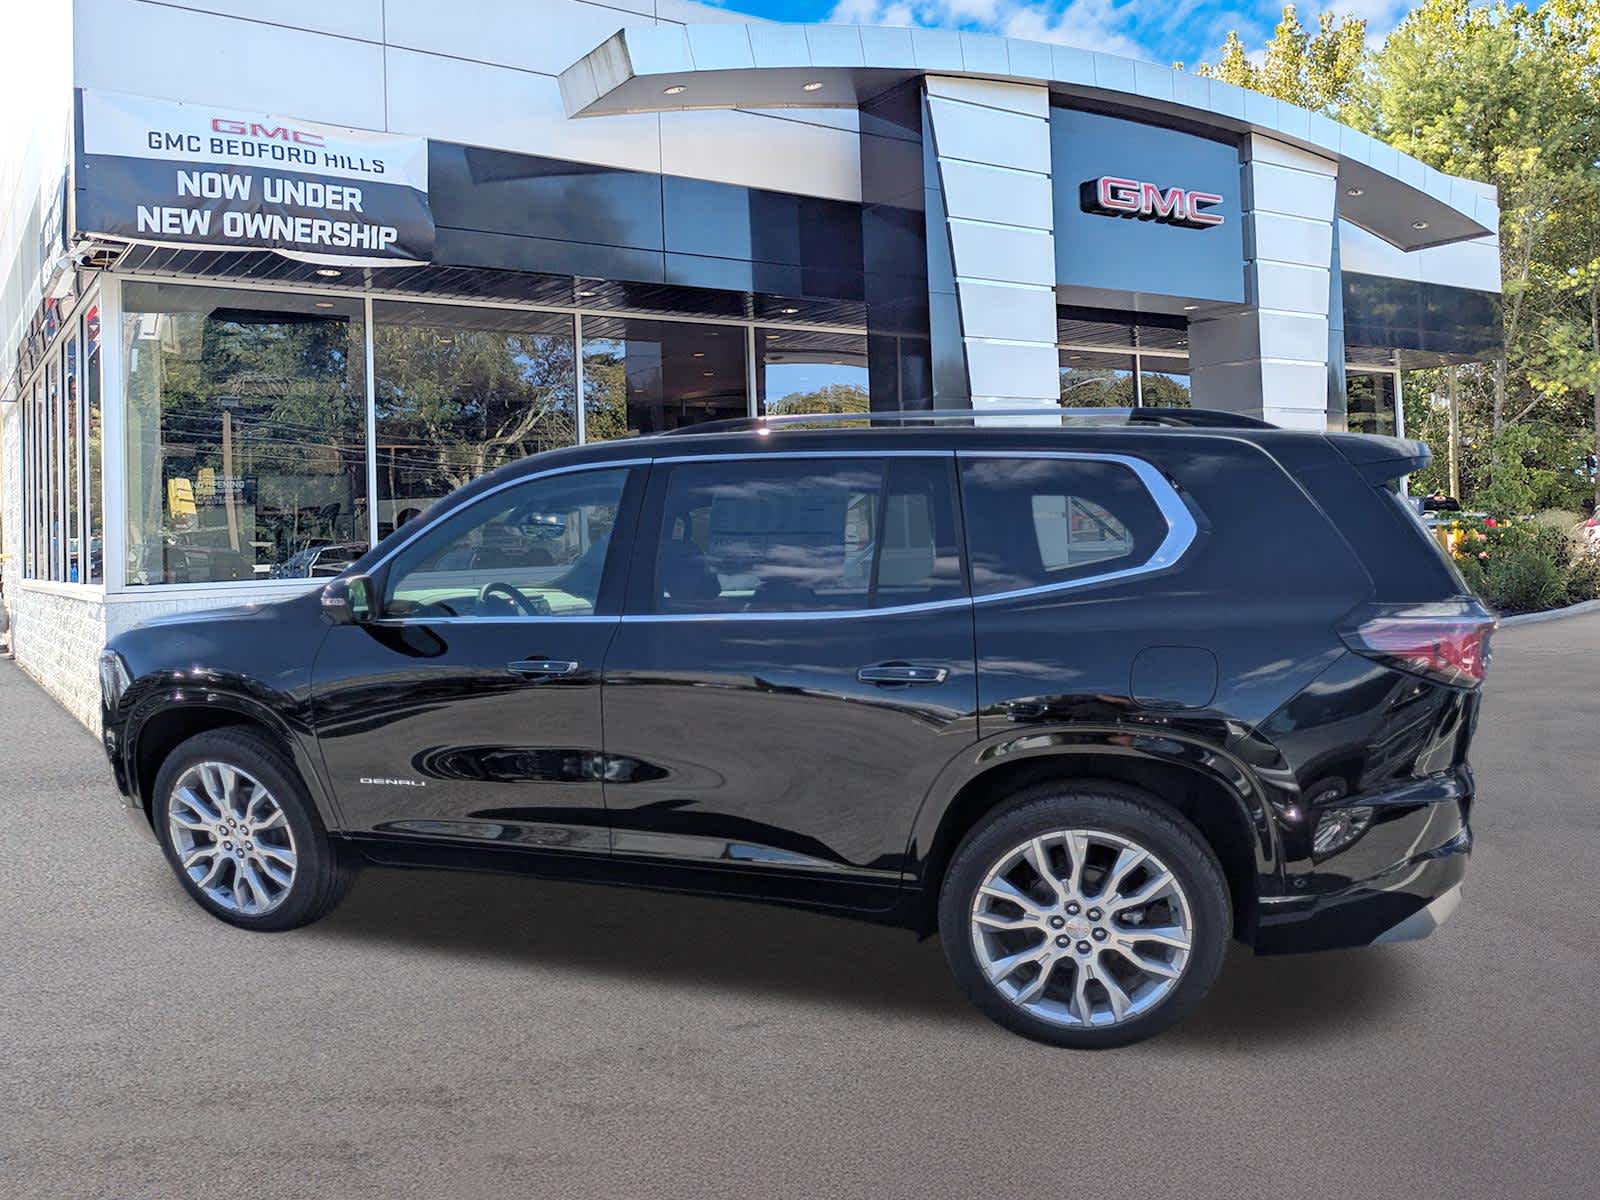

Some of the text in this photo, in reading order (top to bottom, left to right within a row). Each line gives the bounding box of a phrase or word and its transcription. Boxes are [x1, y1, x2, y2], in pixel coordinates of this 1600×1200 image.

[148, 131, 385, 174] GMC BEDFORD HILLS
[211, 118, 325, 148] GMC
[177, 170, 363, 213] NOW UNDER
[1095, 175, 1225, 226] GMC
[137, 205, 398, 250] NEW OWNERSHIP
[360, 778, 426, 786] DENALI
